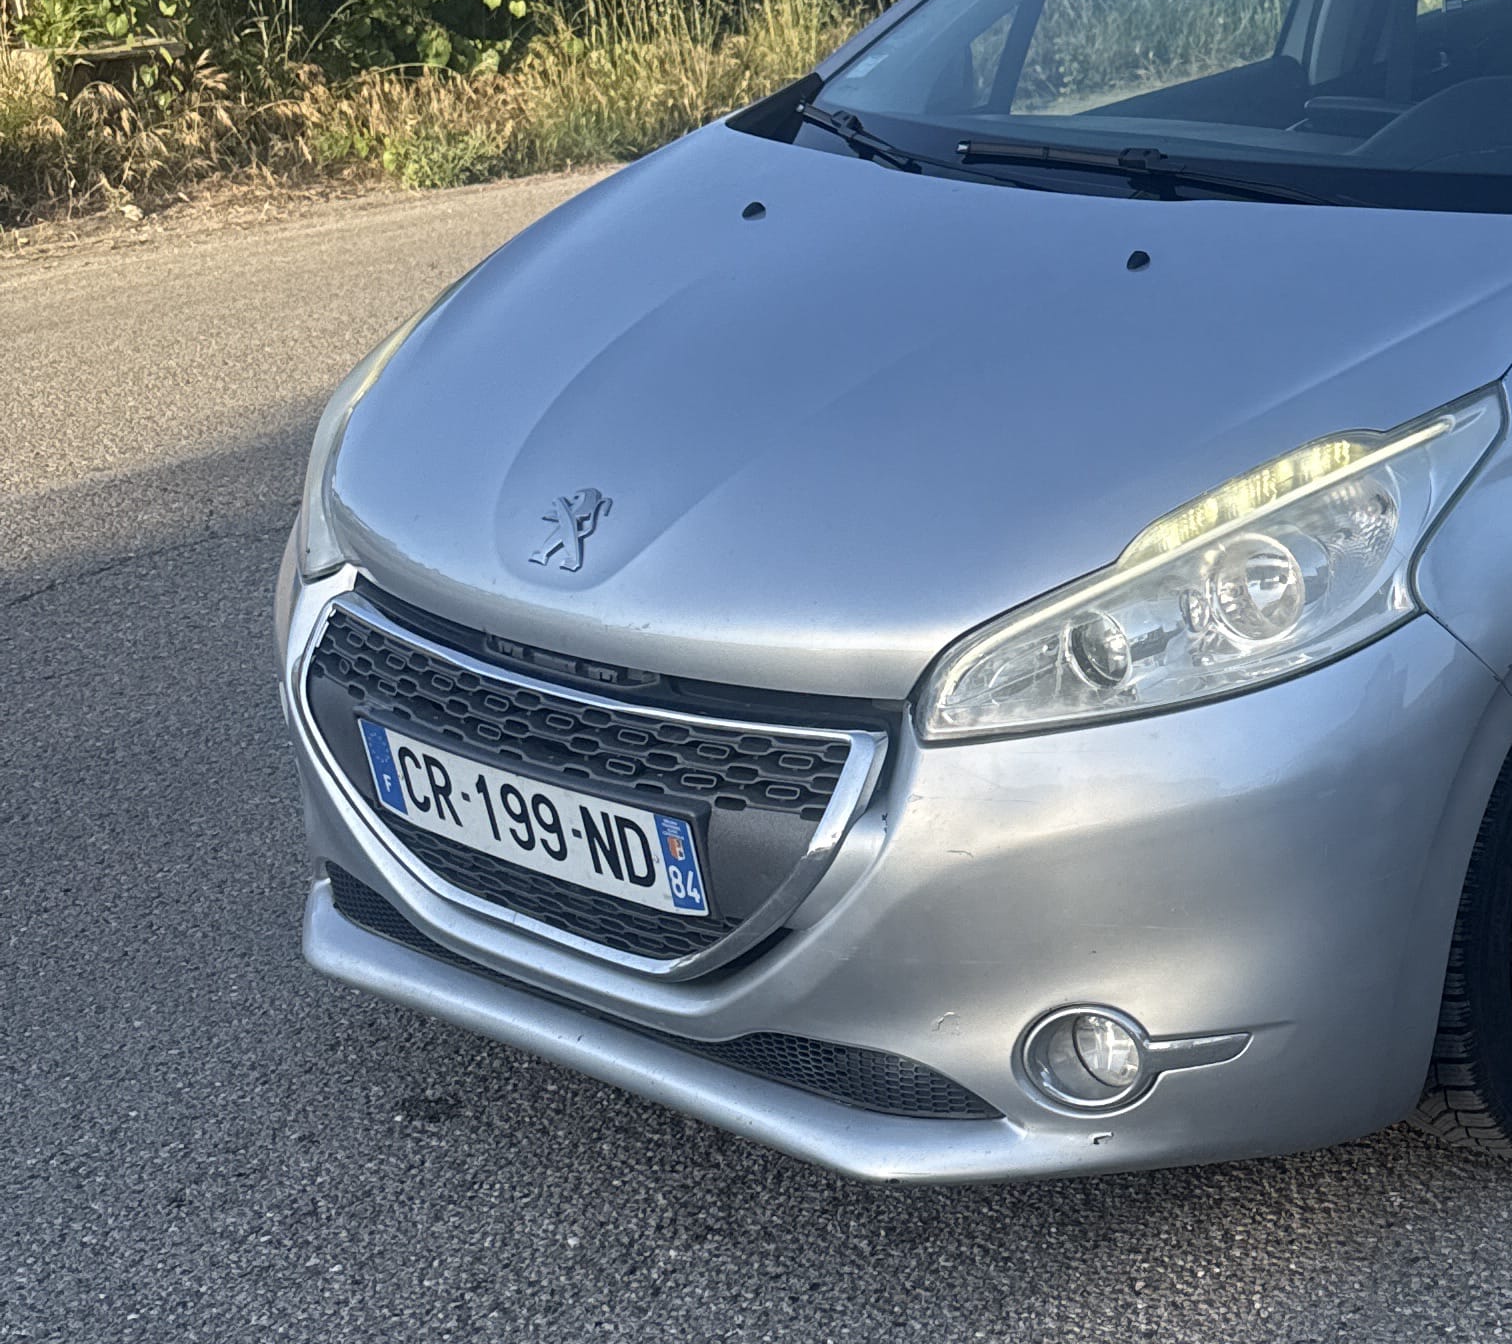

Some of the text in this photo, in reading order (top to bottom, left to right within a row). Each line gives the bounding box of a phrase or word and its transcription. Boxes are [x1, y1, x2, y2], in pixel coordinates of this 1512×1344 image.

[382, 773, 392, 793] F
[398, 746, 656, 888] CR-199-ND
[668, 865, 701, 904] 84
